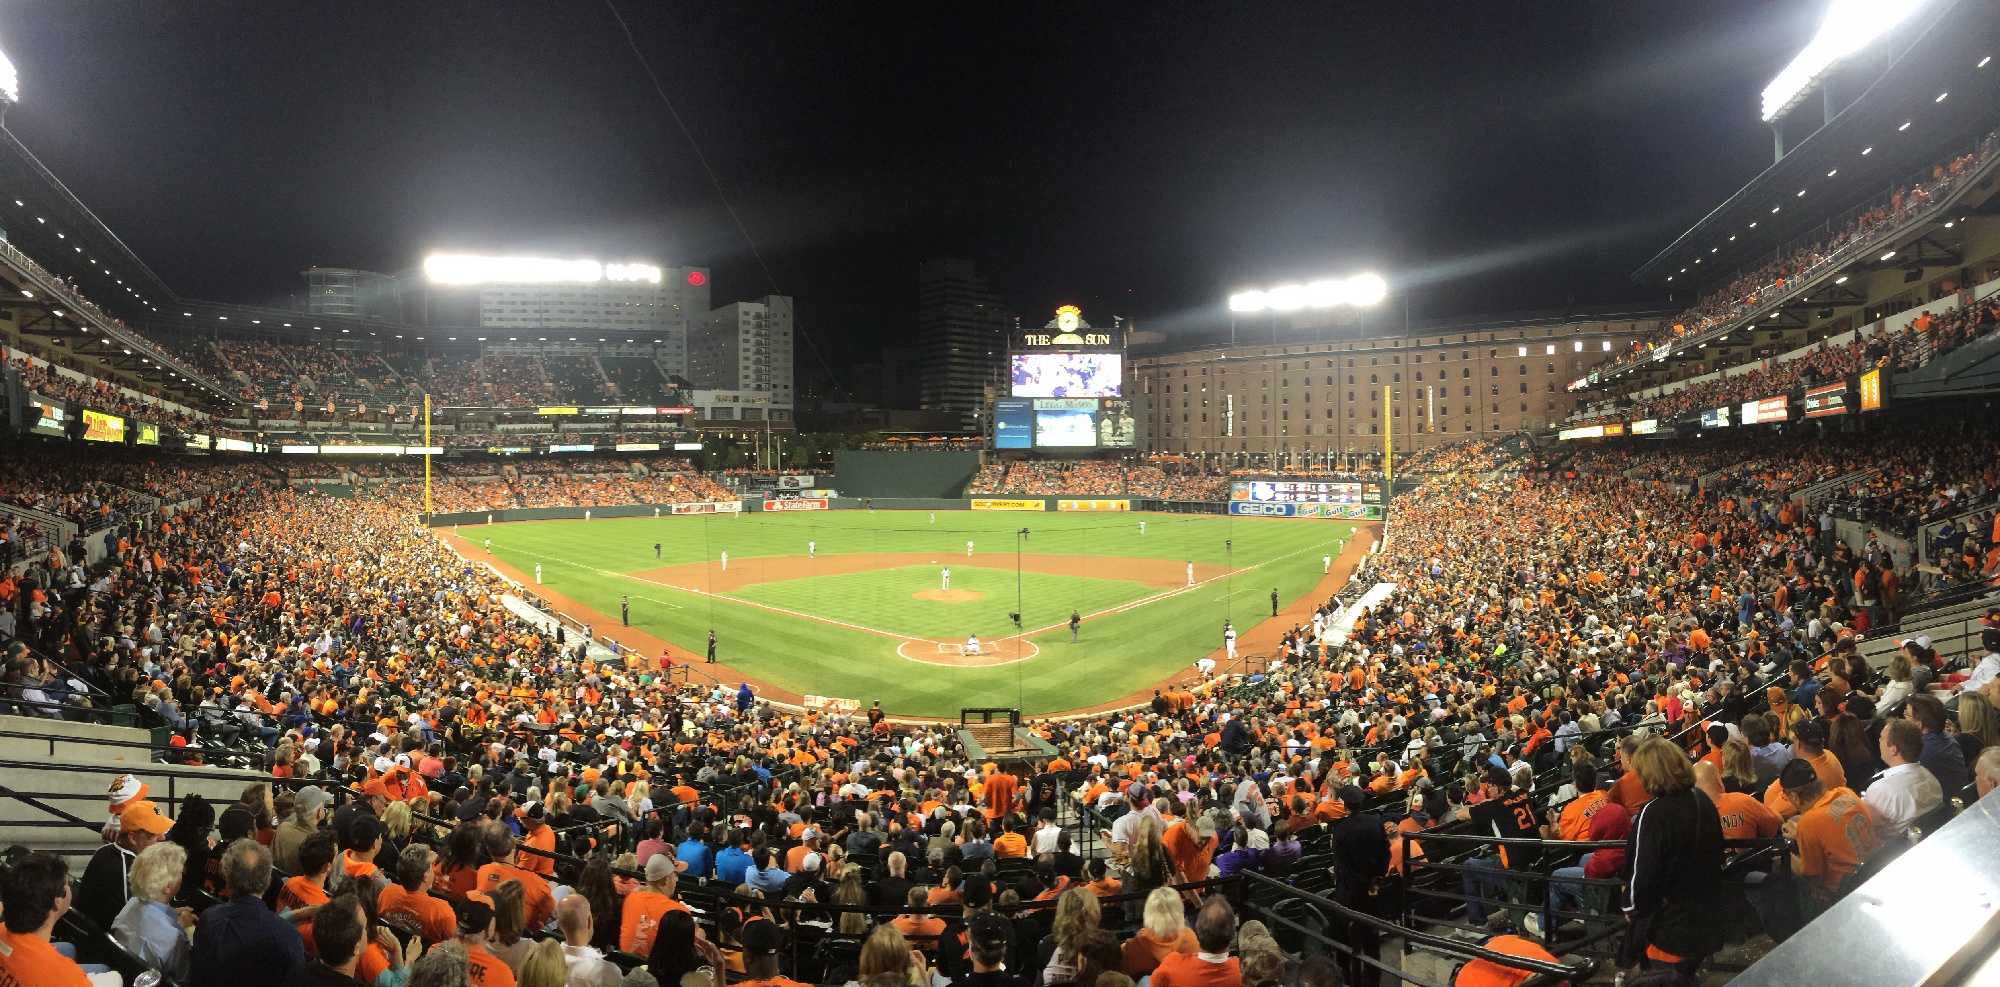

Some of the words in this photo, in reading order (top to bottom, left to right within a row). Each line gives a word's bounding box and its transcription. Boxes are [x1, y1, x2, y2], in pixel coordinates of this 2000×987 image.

[1025, 334, 1051, 346] THE
[1085, 333, 1111, 346] SUN
[1238, 503, 1287, 515] GEICO
[1513, 803, 1537, 830] 21
